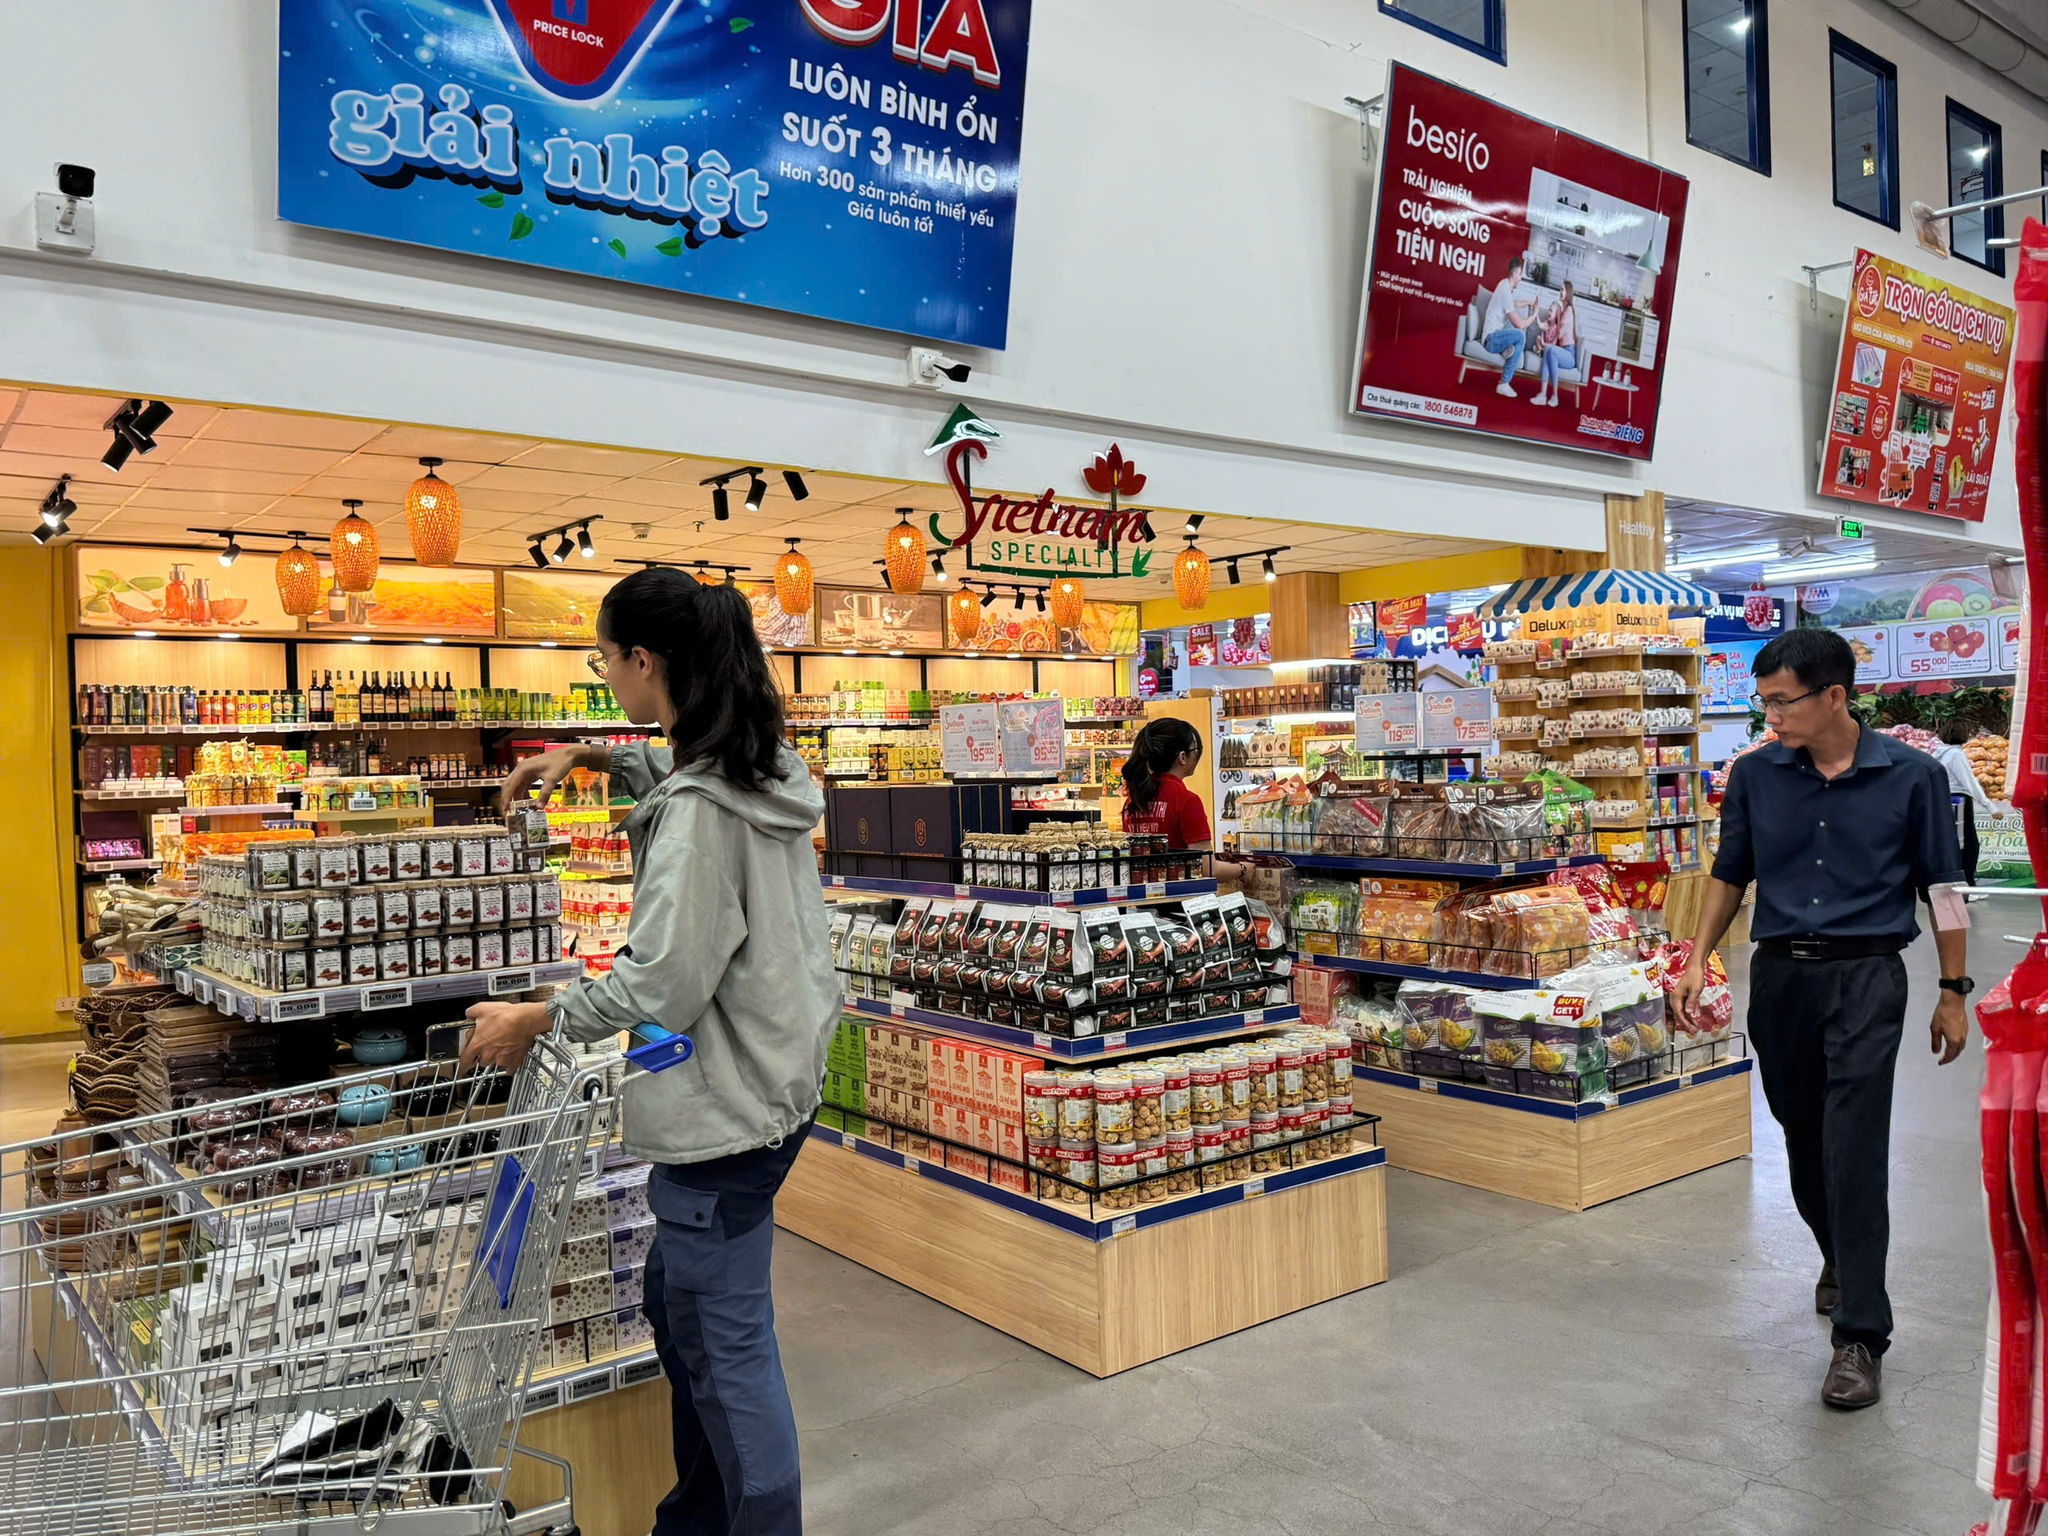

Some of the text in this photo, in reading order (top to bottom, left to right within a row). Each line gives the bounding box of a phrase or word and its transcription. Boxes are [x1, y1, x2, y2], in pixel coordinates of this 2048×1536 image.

[533, 19, 604, 48] PRICE LOCK
[789, 58, 998, 144] LUÔN BÌNH ỔN
[329, 83, 769, 240] giải nhiệt
[782, 112, 997, 193] SUỐT 3 THÁNG
[1403, 167, 1428, 189] TRẢI
[780, 161, 995, 229] Hơn 300 sản phẩm thiết yếu
[847, 200, 935, 235] Giá luôn tốt
[1399, 198, 1446, 227] CUỘC
[1396, 229, 1486, 278] TIỆN NGHI
[1885, 276, 2006, 355] TRỌN GÓI DỊCH VỤ
[1367, 392, 1378, 402] Cho
[1424, 401, 1442, 412] 1800
[1443, 404, 1473, 419] 646878
[1615, 422, 1644, 443] RIÊNG
[947, 438, 1146, 547] Vietnam
[1618, 519, 1656, 540] Healthy
[991, 540, 1119, 569] SPECIALTY
[1191, 626, 1211, 638] SALE
[1411, 625, 1449, 650] DỊC
[1995, 831, 2027, 848] Toà
[1555, 1006, 1573, 1015] GET
